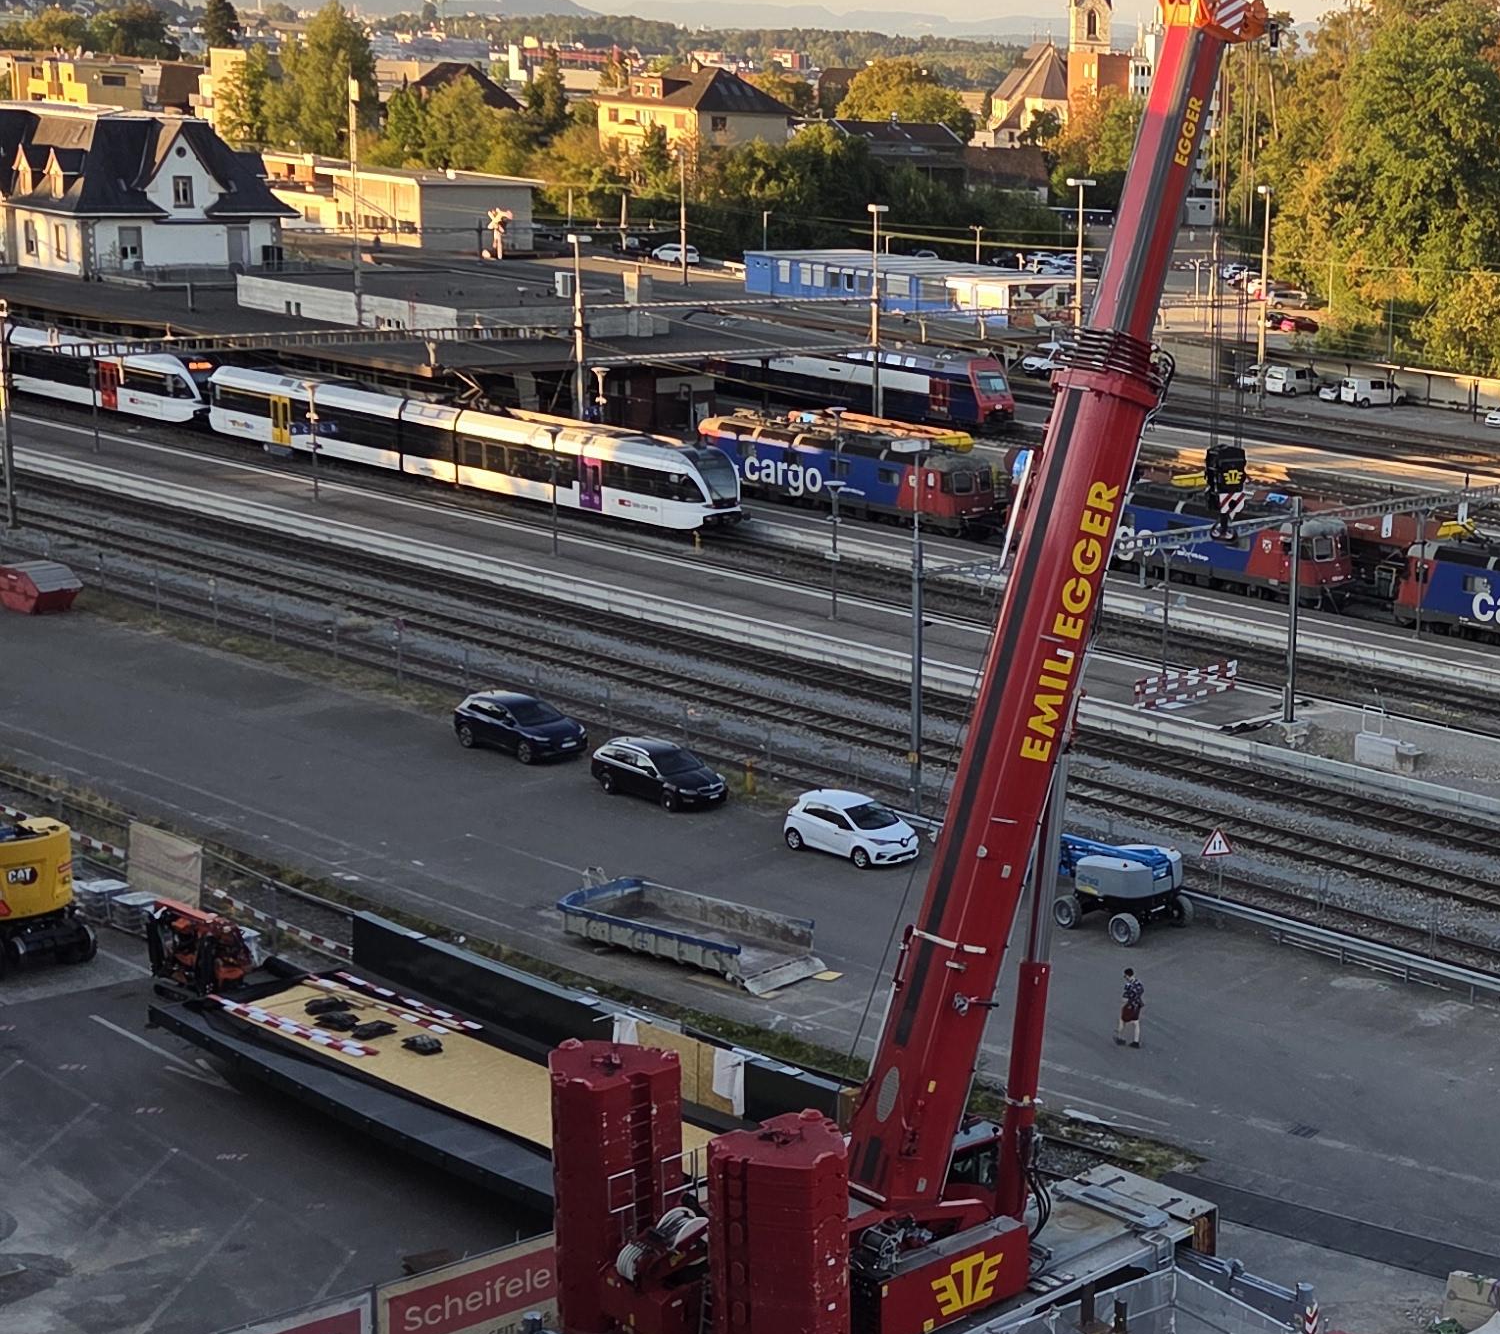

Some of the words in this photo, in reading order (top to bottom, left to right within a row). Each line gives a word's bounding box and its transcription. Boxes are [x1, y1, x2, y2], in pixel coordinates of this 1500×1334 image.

[1174, 96, 1204, 167] EGGER
[744, 455, 822, 496] cargo
[1020, 649, 1075, 762] EMIL
[1052, 480, 1120, 640] EGGER
[8, 867, 32, 883] CAT
[403, 1268, 551, 1332] Scheifele
